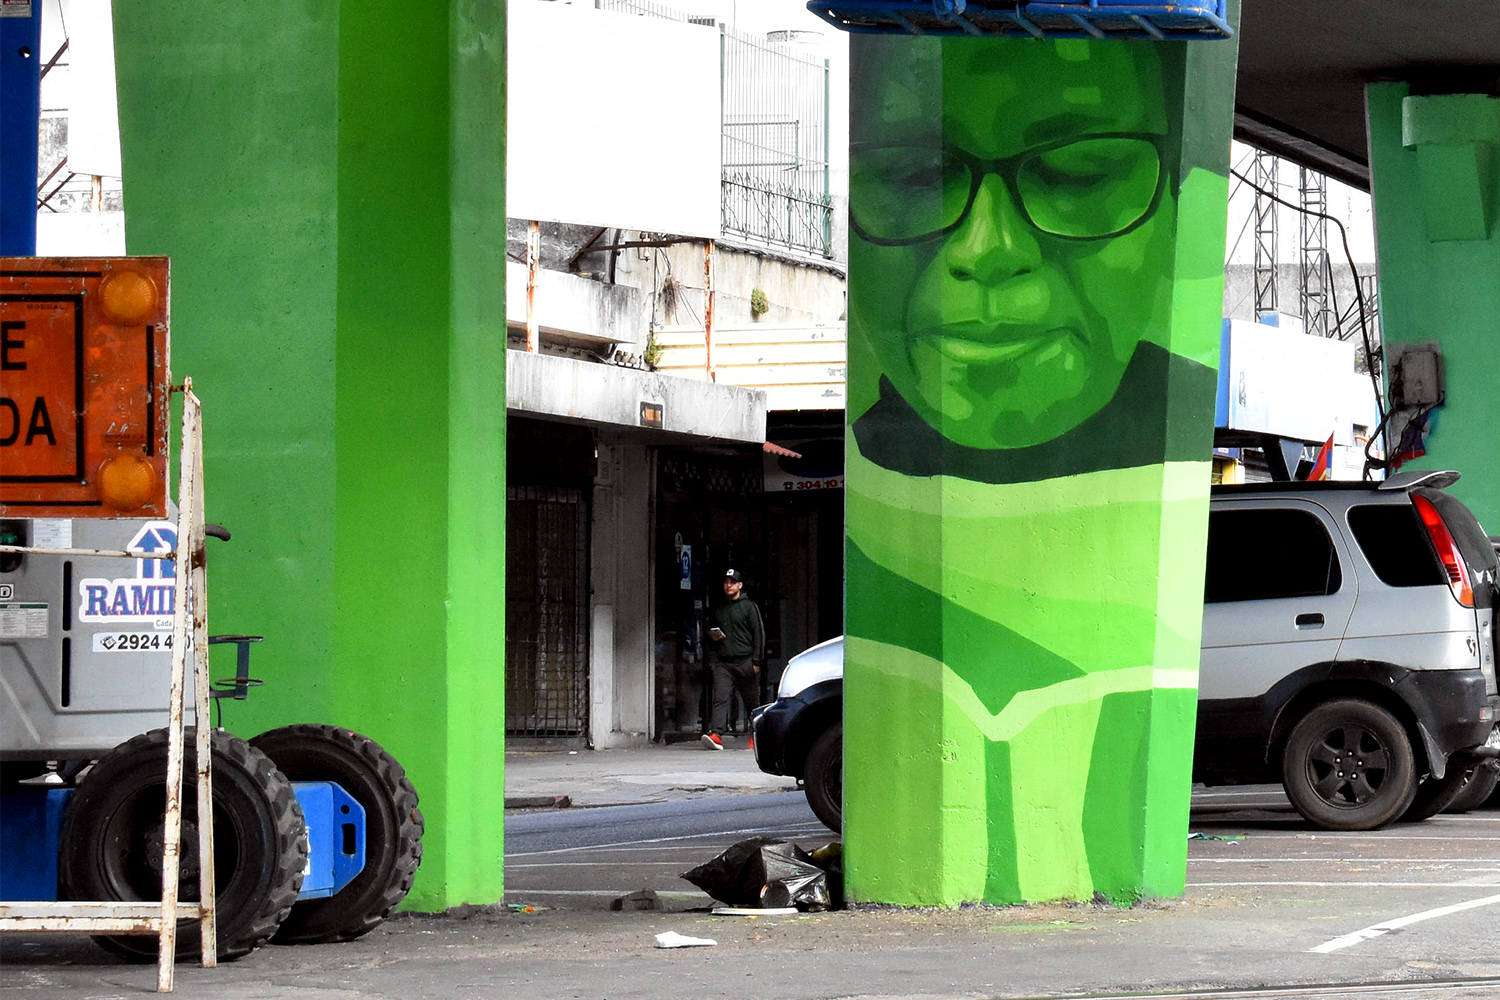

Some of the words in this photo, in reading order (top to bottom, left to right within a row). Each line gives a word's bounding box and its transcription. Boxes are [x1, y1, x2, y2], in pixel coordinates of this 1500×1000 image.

[85, 585, 175, 616] RAMI
[156, 619, 173, 627] Cada
[118, 634, 159, 649] 2924
